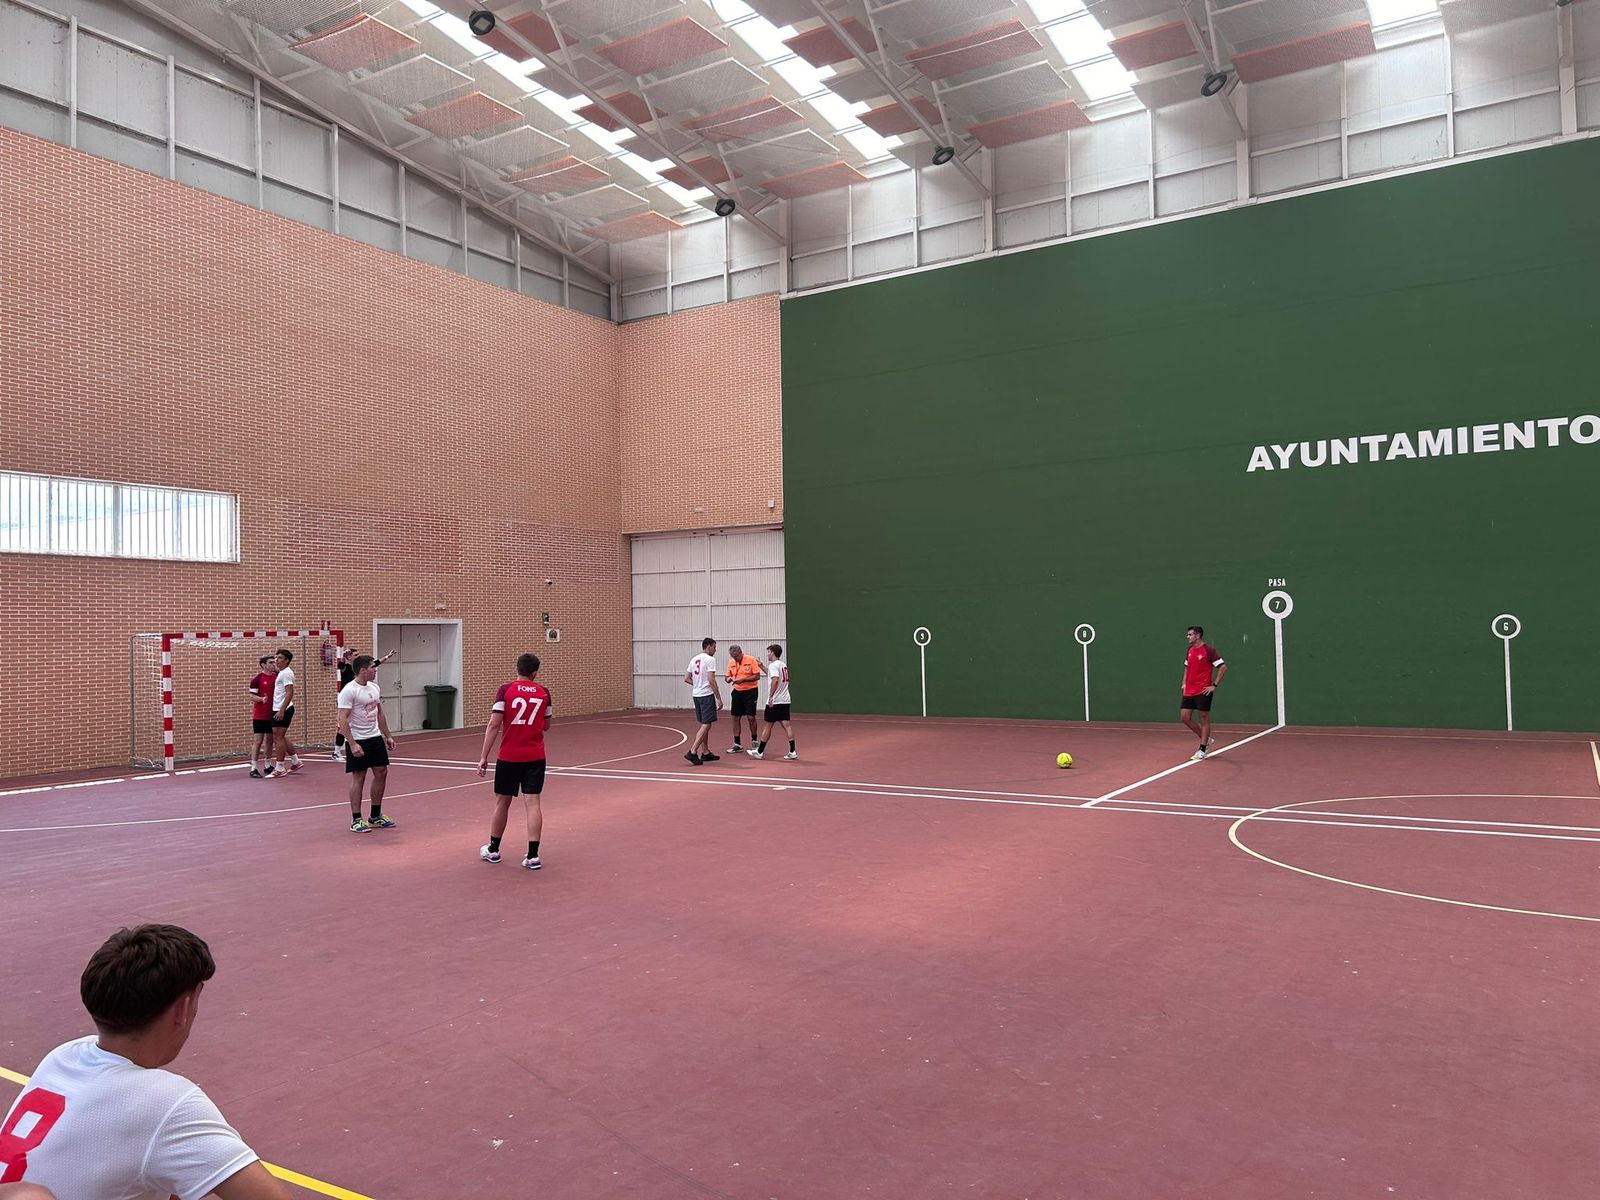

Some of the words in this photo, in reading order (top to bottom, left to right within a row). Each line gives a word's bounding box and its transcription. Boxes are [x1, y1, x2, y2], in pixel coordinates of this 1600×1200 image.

[1246, 414, 1600, 472] AYUNTAMIENTO
[1268, 578, 1287, 587] PASA
[1275, 600, 1280, 610] 7
[1503, 622, 1509, 631] 6
[694, 659, 701, 675] 3
[517, 685, 537, 693] FONS
[511, 697, 543, 725] 27
